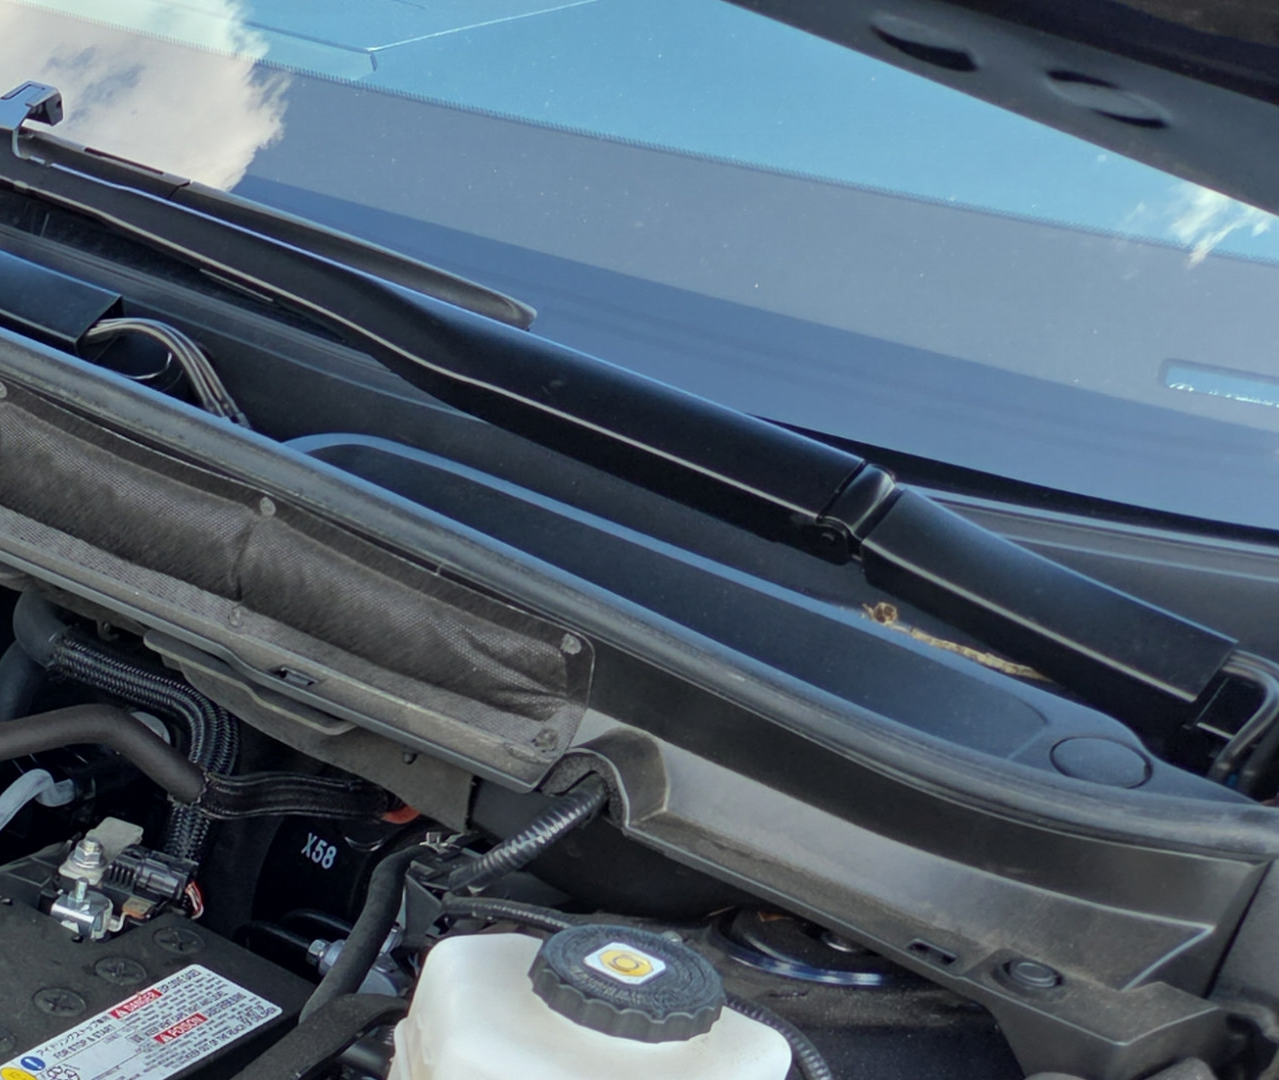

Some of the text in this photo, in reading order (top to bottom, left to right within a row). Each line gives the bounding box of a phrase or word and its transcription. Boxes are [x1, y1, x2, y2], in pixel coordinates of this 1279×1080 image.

[300, 832, 337, 869] X58
[121, 991, 159, 1011] DANGER
[166, 1016, 203, 1036] POISON
[52, 1047, 73, 1059] FOR
[67, 1039, 89, 1051] STOP
[91, 1024, 117, 1038] START
